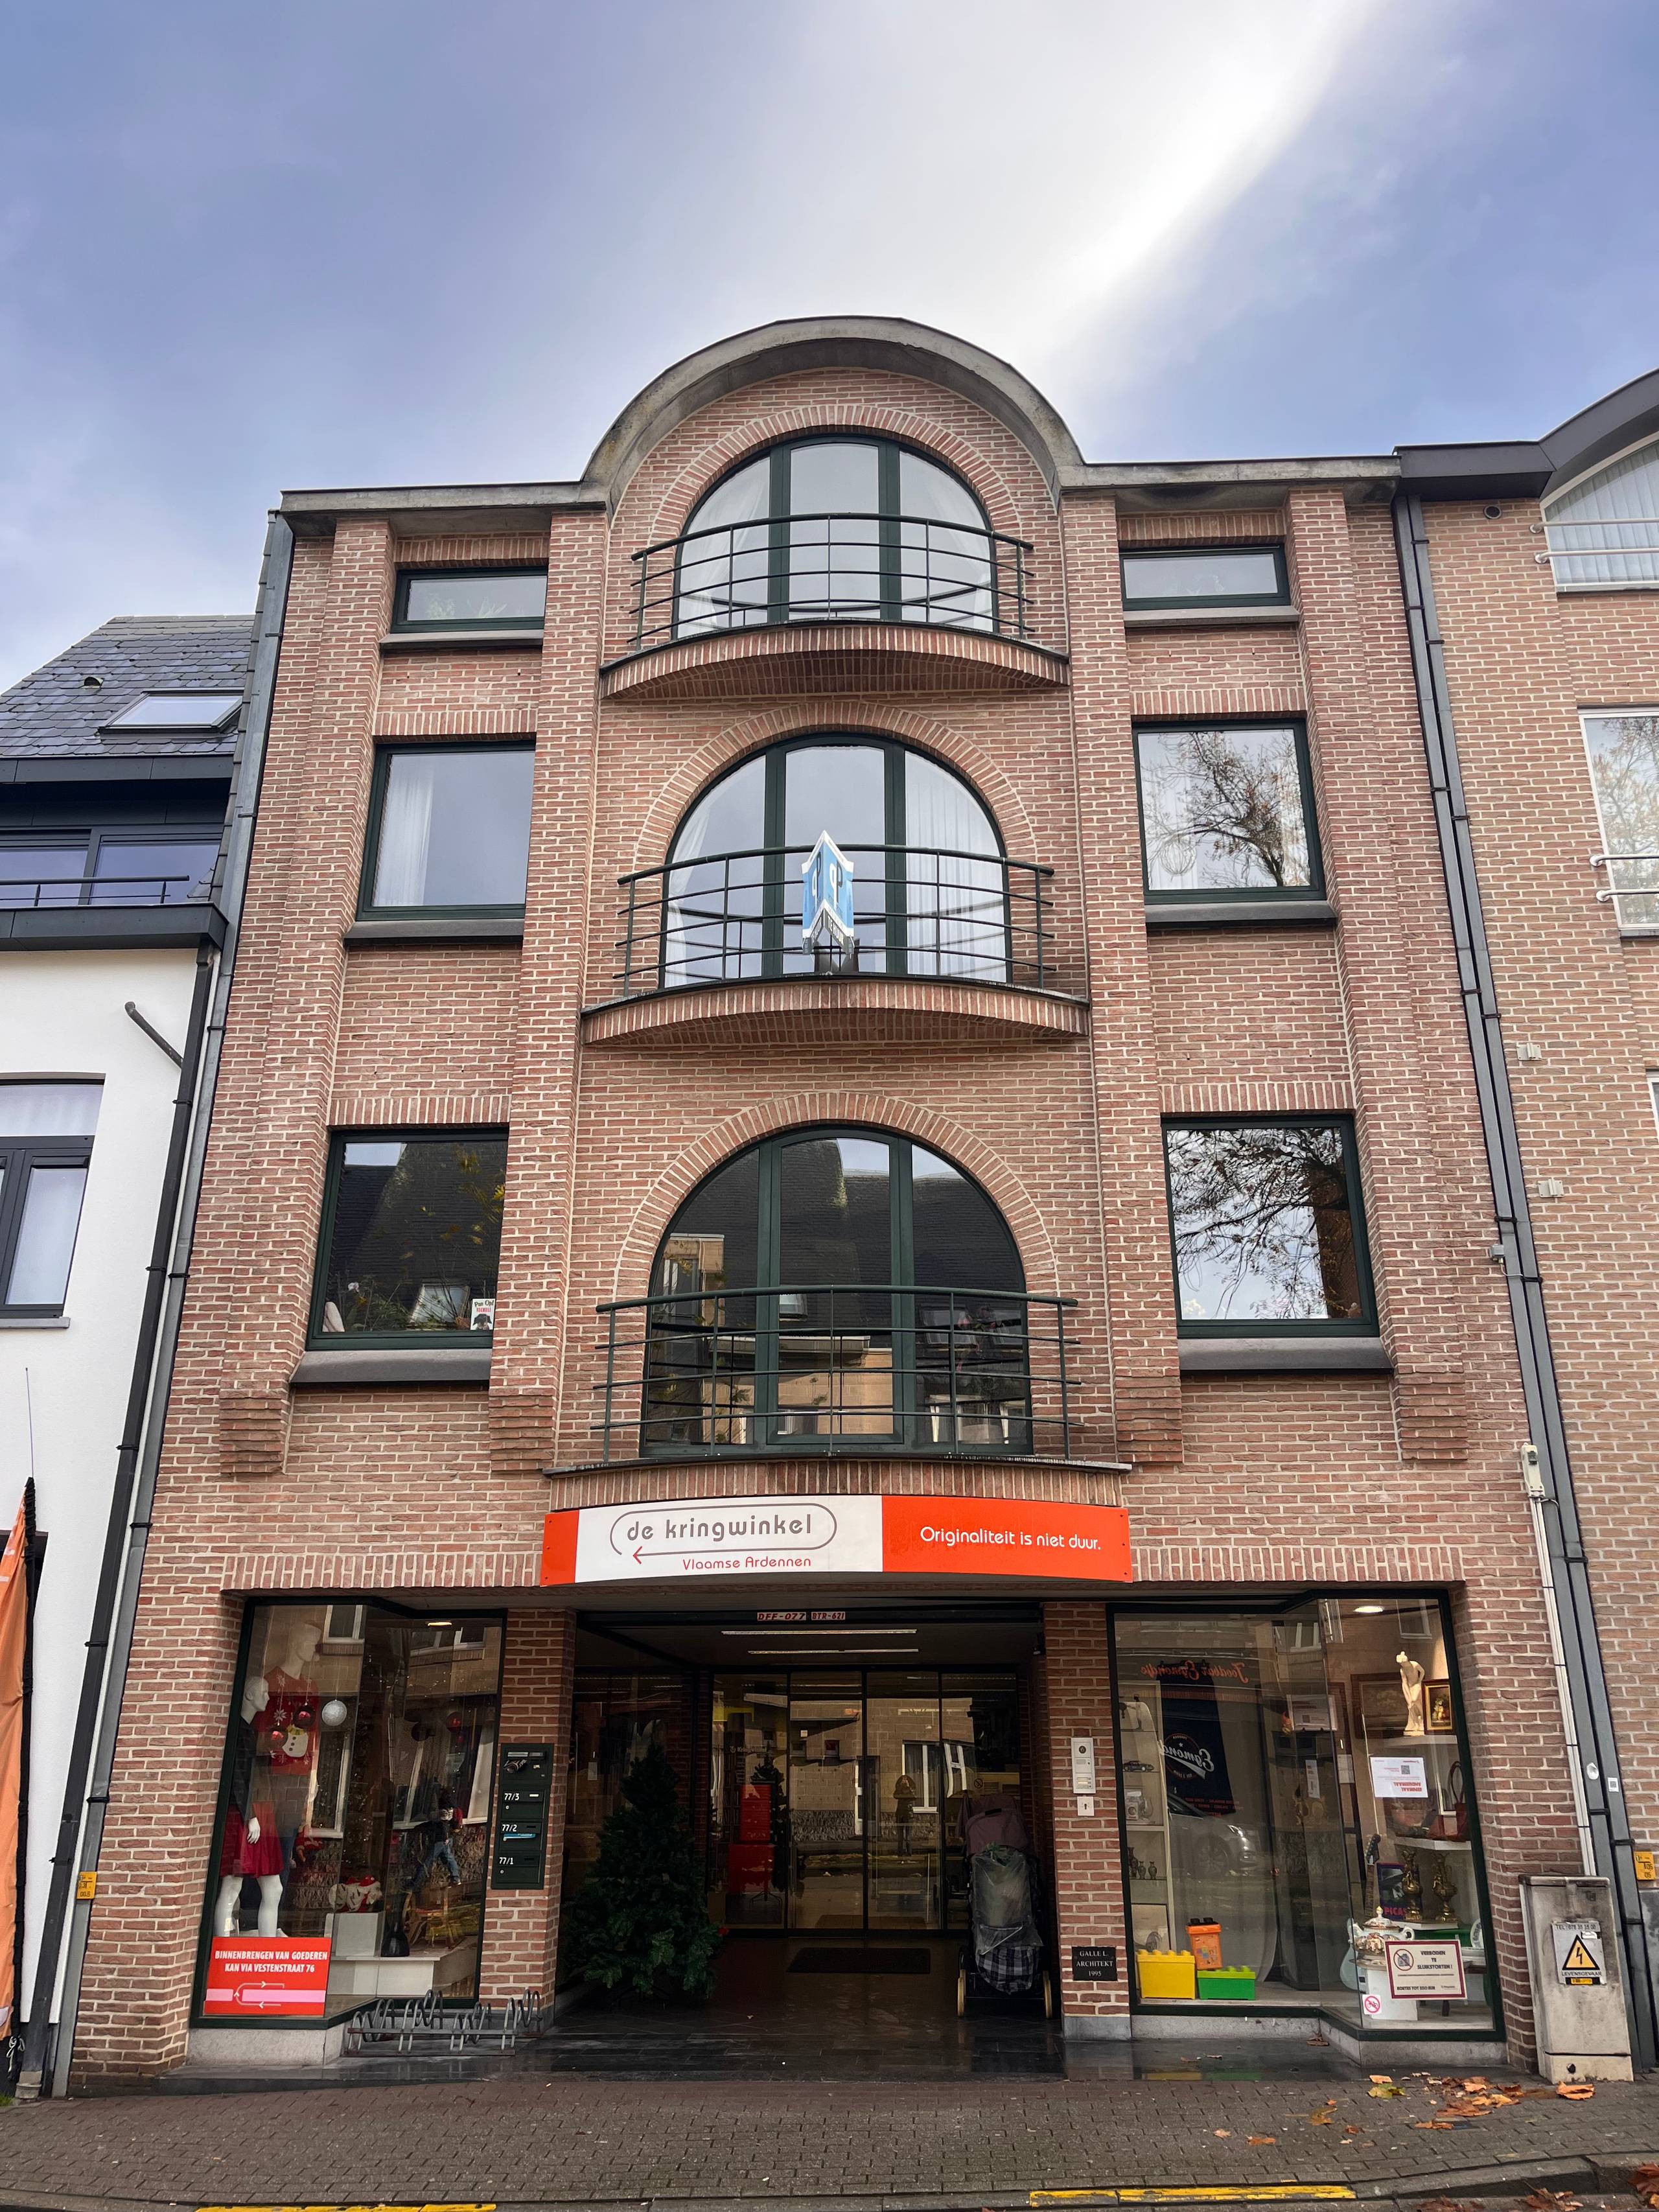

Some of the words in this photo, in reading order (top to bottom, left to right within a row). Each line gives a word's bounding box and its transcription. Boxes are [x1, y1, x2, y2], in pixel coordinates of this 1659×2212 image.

[828, 914, 833, 933] TE
[833, 922, 844, 946] HUUR
[627, 1521, 654, 1541] de
[666, 1514, 811, 1542] kringwinkel
[920, 1526, 1015, 1546] Originaliteit
[1019, 1531, 1032, 1545] is
[1036, 1533, 1065, 1548] niet
[1069, 1533, 1101, 1550] duur.
[682, 1558, 740, 1570] Vlaamse
[745, 1556, 811, 1568] Ardennen
[502, 1824, 517, 1832] 77/2
[499, 1857, 514, 1865] 77/1
[215, 1950, 274, 1960] BINNENBRENGEN
[275, 1951, 290, 1960] VAN
[292, 1951, 328, 1961] GOEDEREN
[225, 1963, 239, 1972] KAN
[241, 1964, 253, 1972] VIA
[253, 1964, 304, 1972] VESTENSTRAAT
[306, 1964, 315, 1973] 76
